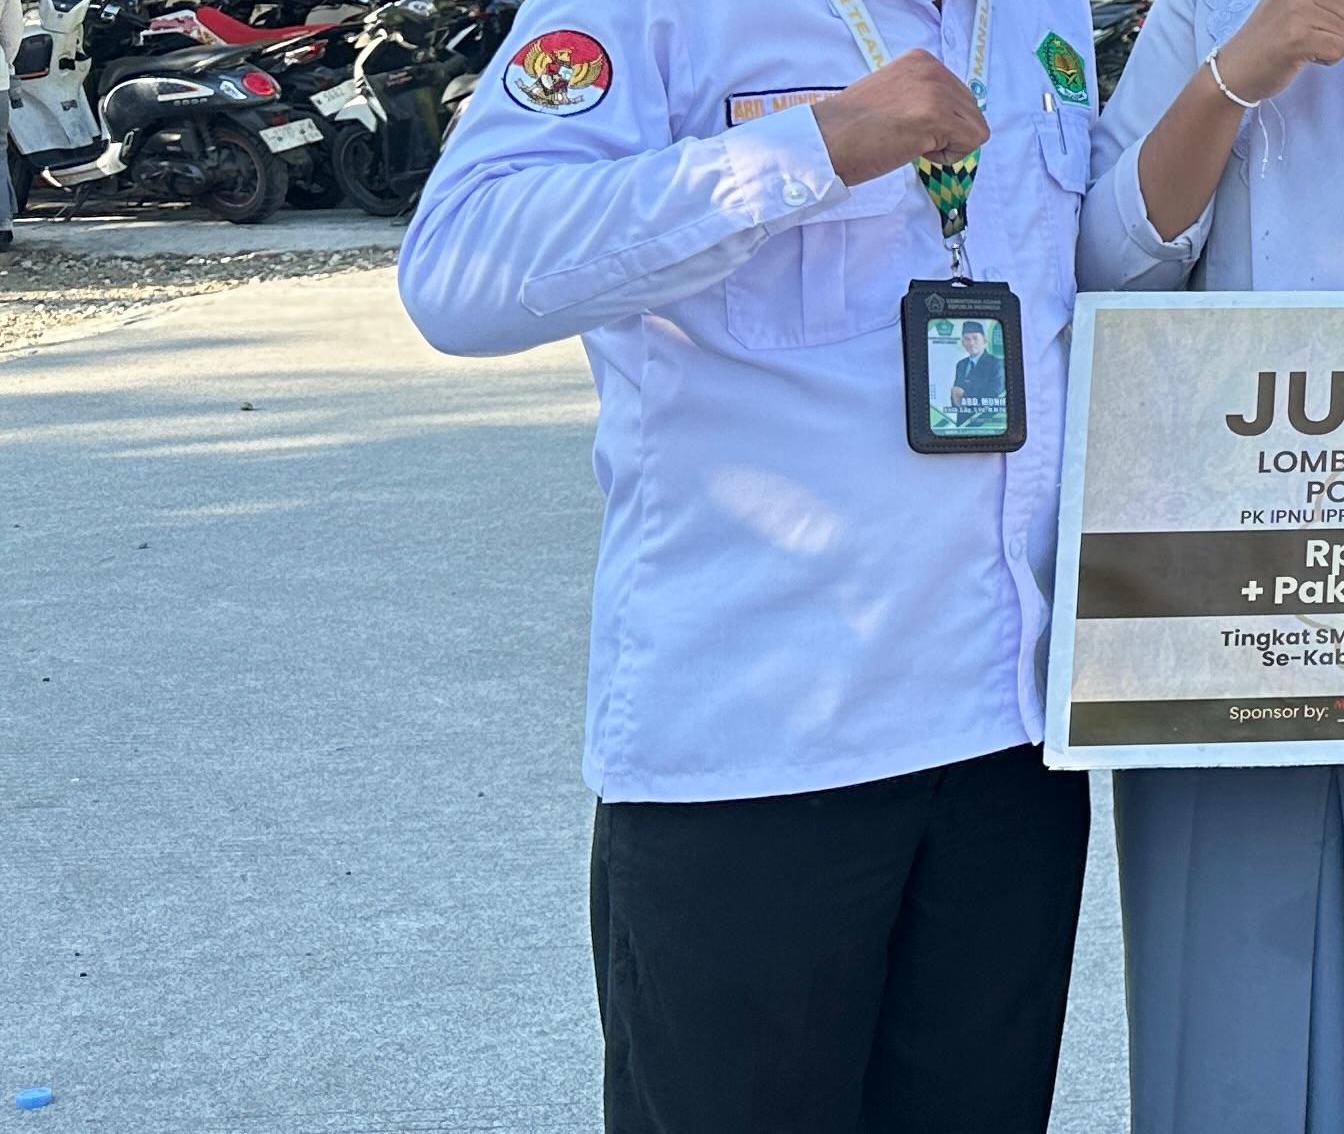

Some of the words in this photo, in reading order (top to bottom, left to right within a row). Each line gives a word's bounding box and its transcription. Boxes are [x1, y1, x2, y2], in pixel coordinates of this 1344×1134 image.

[1240, 511, 1265, 524] PK
[1270, 509, 1315, 524] IPNU
[1241, 580, 1263, 601] +
[1221, 628, 1310, 652] Tingkat
[1229, 705, 1299, 724] Sponsor
[1304, 703, 1329, 722] by:
